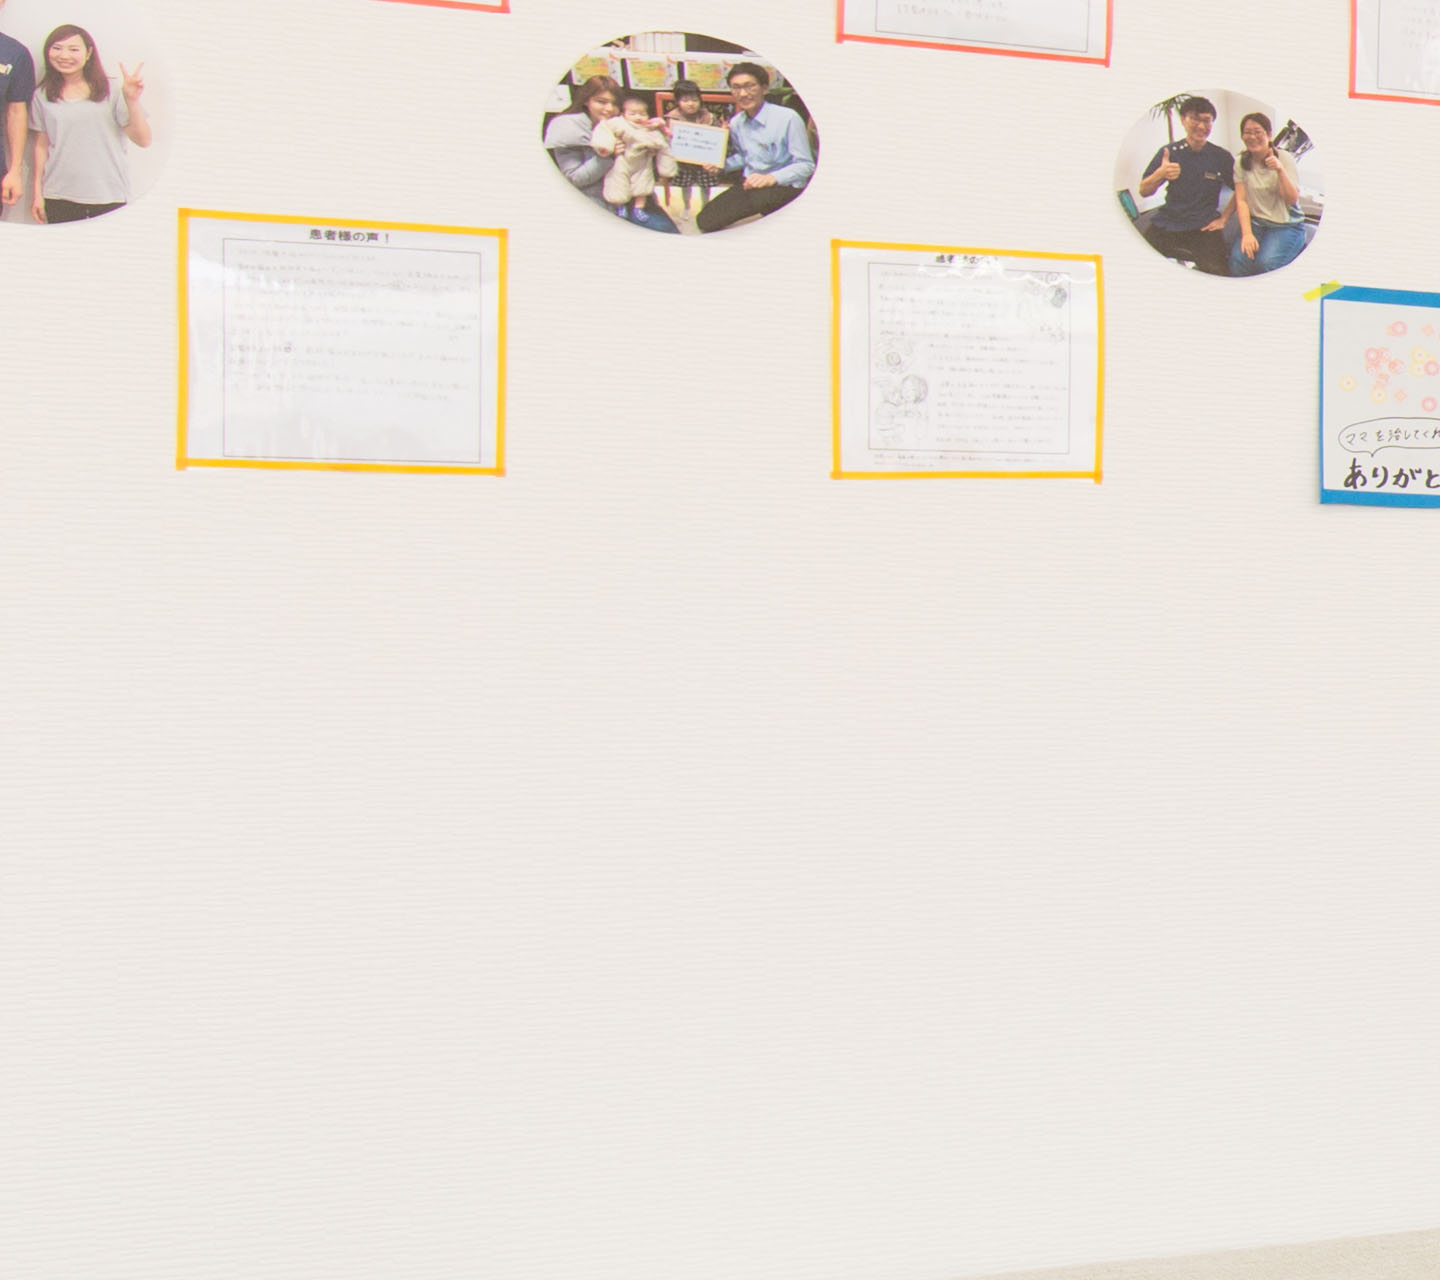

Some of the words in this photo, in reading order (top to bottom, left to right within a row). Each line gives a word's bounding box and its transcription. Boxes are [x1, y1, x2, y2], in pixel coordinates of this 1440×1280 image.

[309, 229, 391, 244] 患者様の声！
